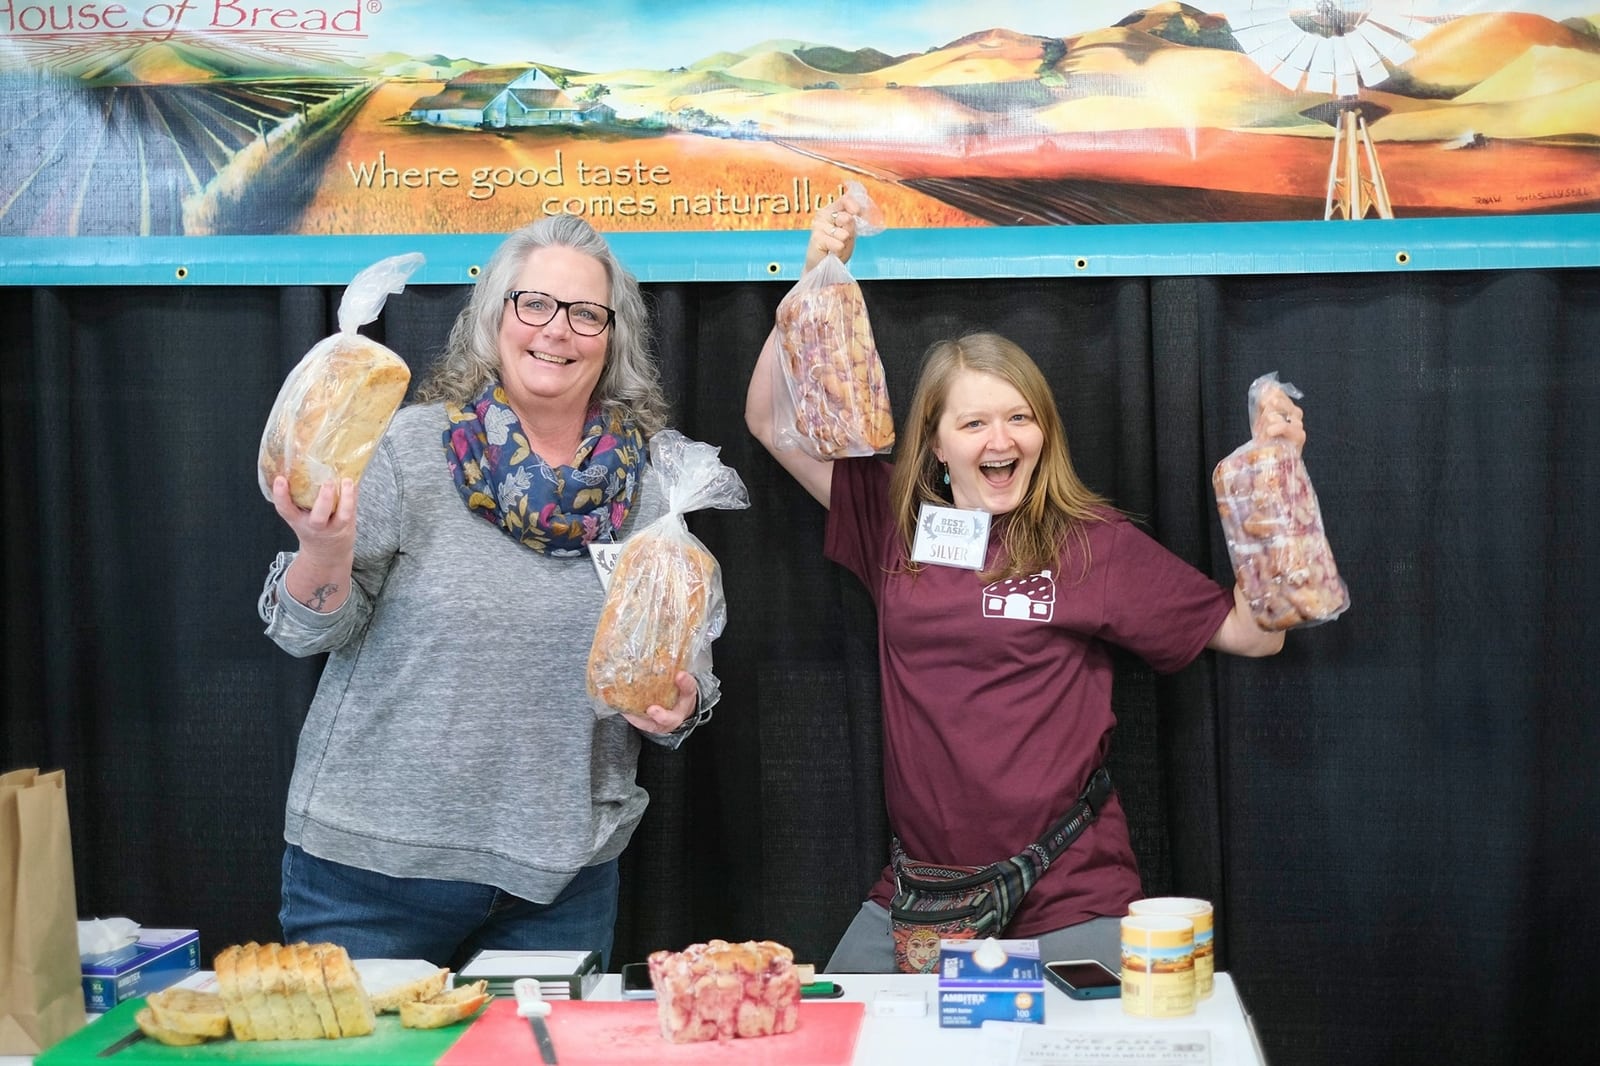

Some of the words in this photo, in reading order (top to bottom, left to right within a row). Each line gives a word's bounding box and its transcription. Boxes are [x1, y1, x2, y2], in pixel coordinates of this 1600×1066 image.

[142, 0, 198, 41] of
[347, 150, 459, 189] Where
[470, 150, 565, 200] good
[576, 158, 671, 187] taste
[541, 193, 657, 217] comes
[934, 526, 970, 536] ALASKA
[941, 518, 966, 528] BEST
[929, 543, 968, 561] SILVER
[1016, 1009, 1029, 1018] 100
